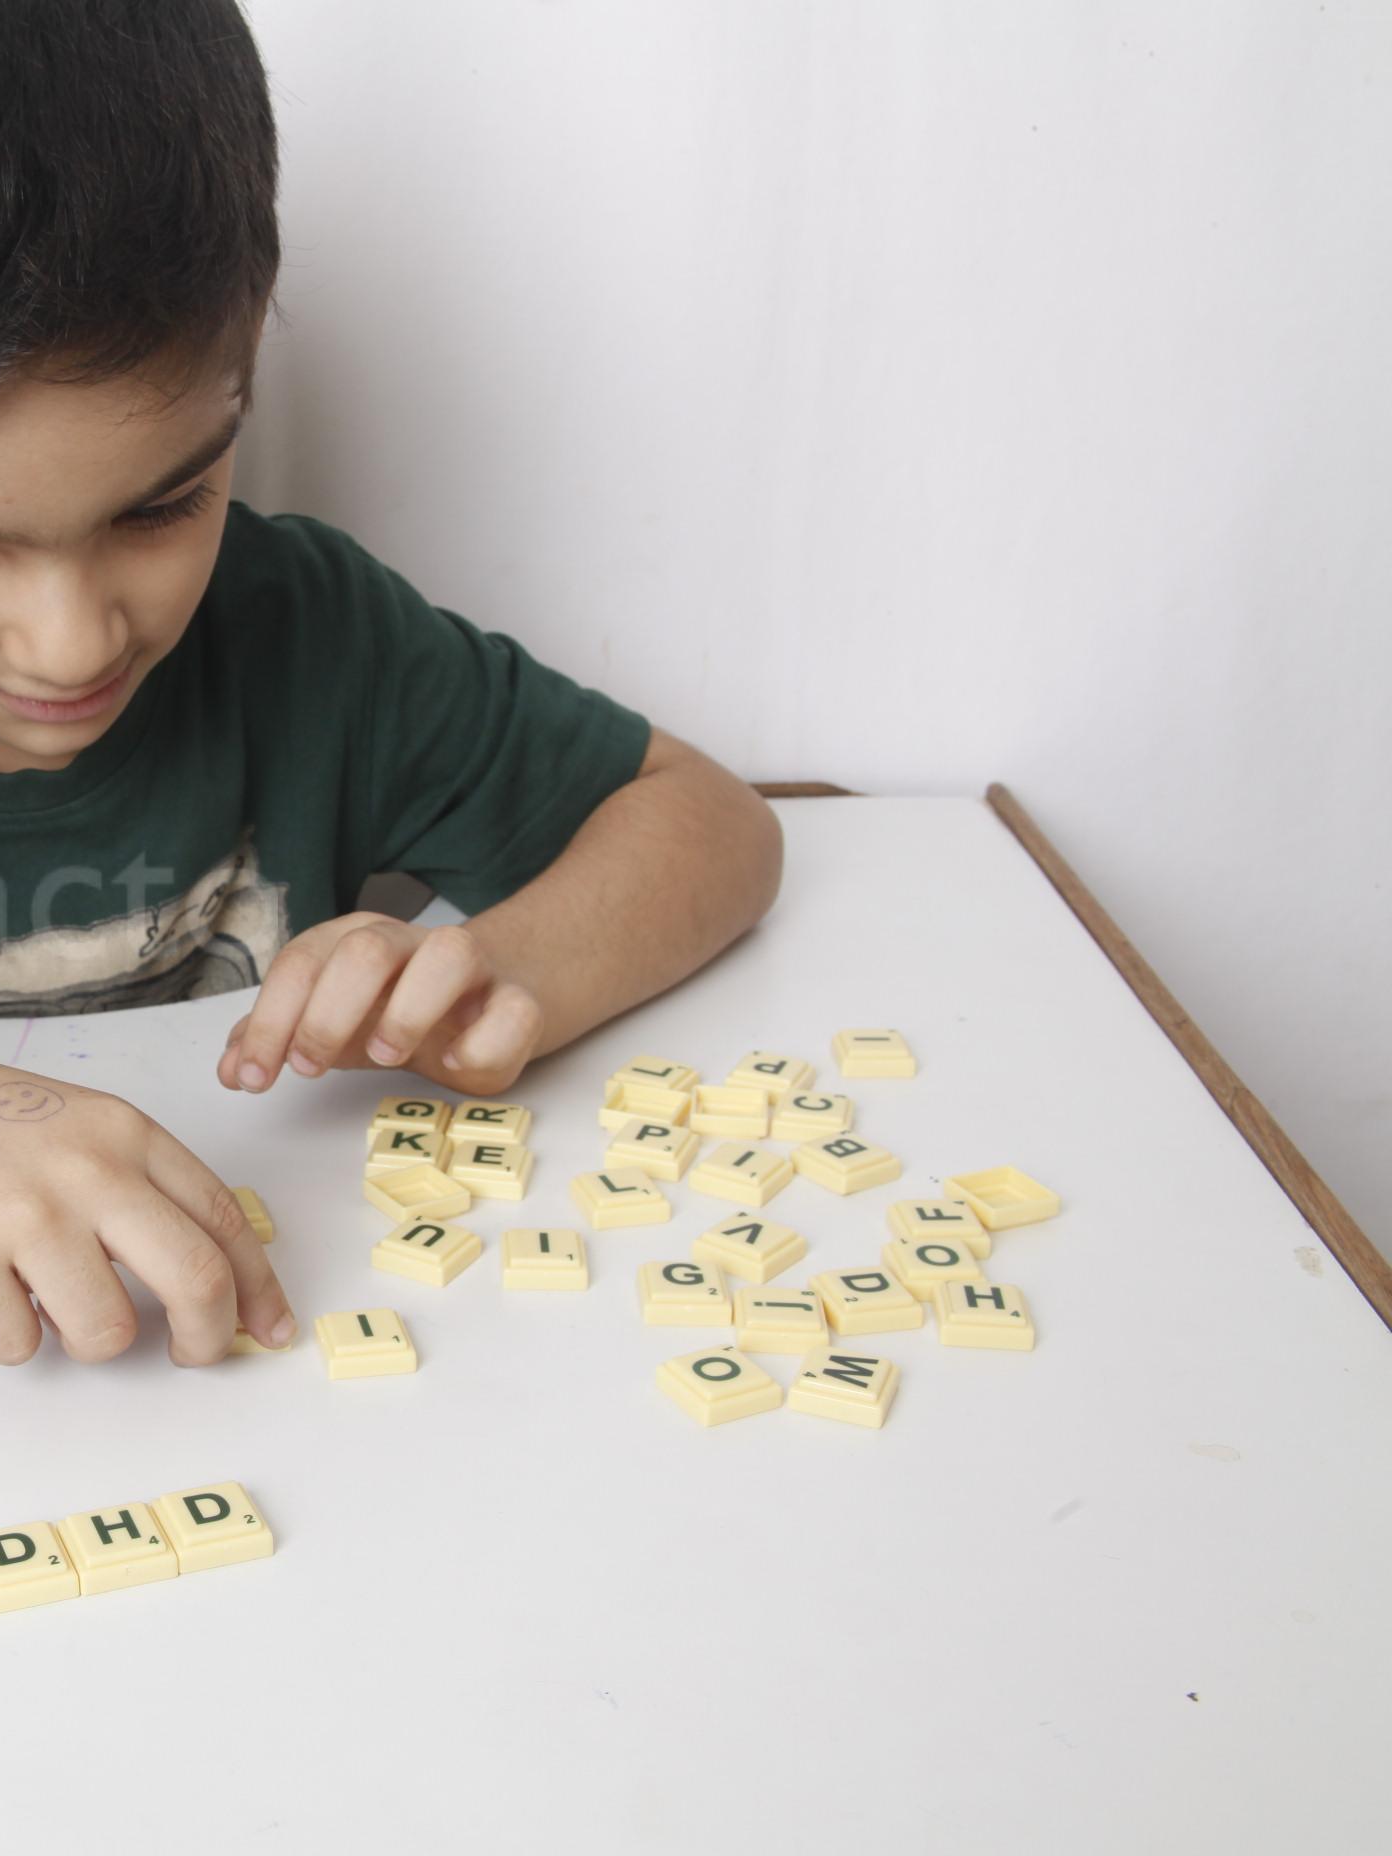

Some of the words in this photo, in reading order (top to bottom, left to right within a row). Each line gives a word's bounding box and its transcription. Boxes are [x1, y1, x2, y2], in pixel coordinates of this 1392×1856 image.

[395, 1101, 436, 1117] G
[465, 1107, 507, 1124] R
[389, 1131, 427, 1152] K
[634, 1123, 671, 1142] P
[471, 1144, 507, 1166] E
[821, 1138, 868, 1159] B
[596, 1174, 639, 1194] L
[915, 1206, 964, 1222] F
[661, 1262, 705, 1286] G
[839, 1272, 891, 1294] D
[962, 1284, 1006, 1311] H
